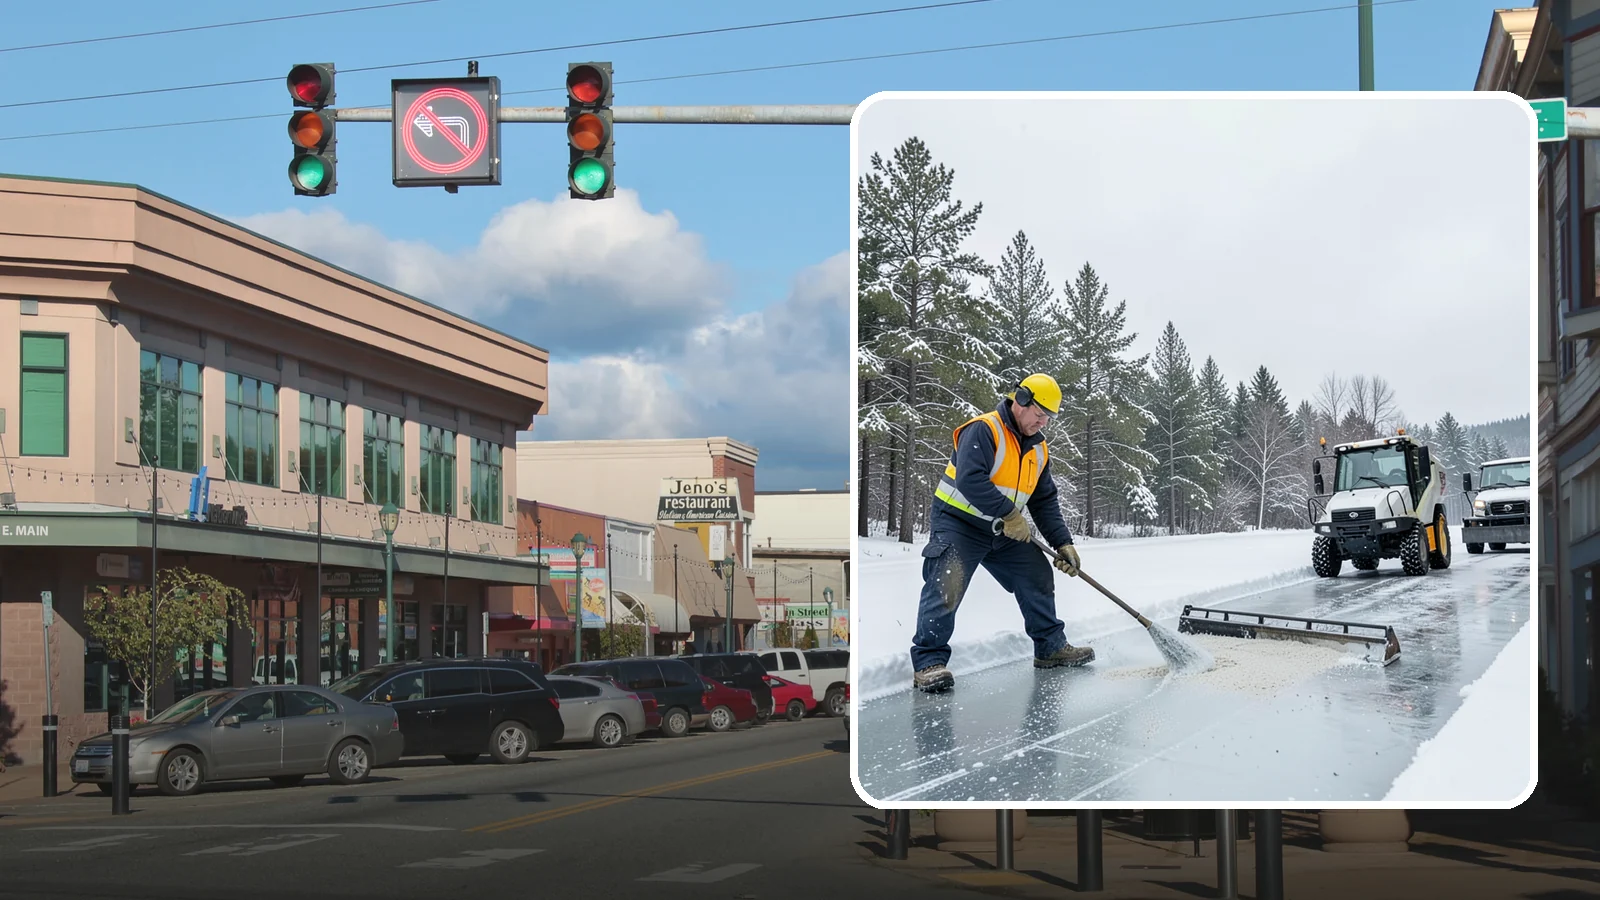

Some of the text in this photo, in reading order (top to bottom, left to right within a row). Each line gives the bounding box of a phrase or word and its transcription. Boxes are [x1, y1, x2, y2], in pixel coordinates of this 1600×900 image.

[669, 480, 728, 494] Jeno's
[665, 496, 731, 509] restaurant
[658, 510, 681, 519] Italian
[685, 510, 715, 519] American
[715, 509, 737, 519] Cuisine
[2, 525, 49, 536] E. MAIN
[797, 608, 828, 617] Street
